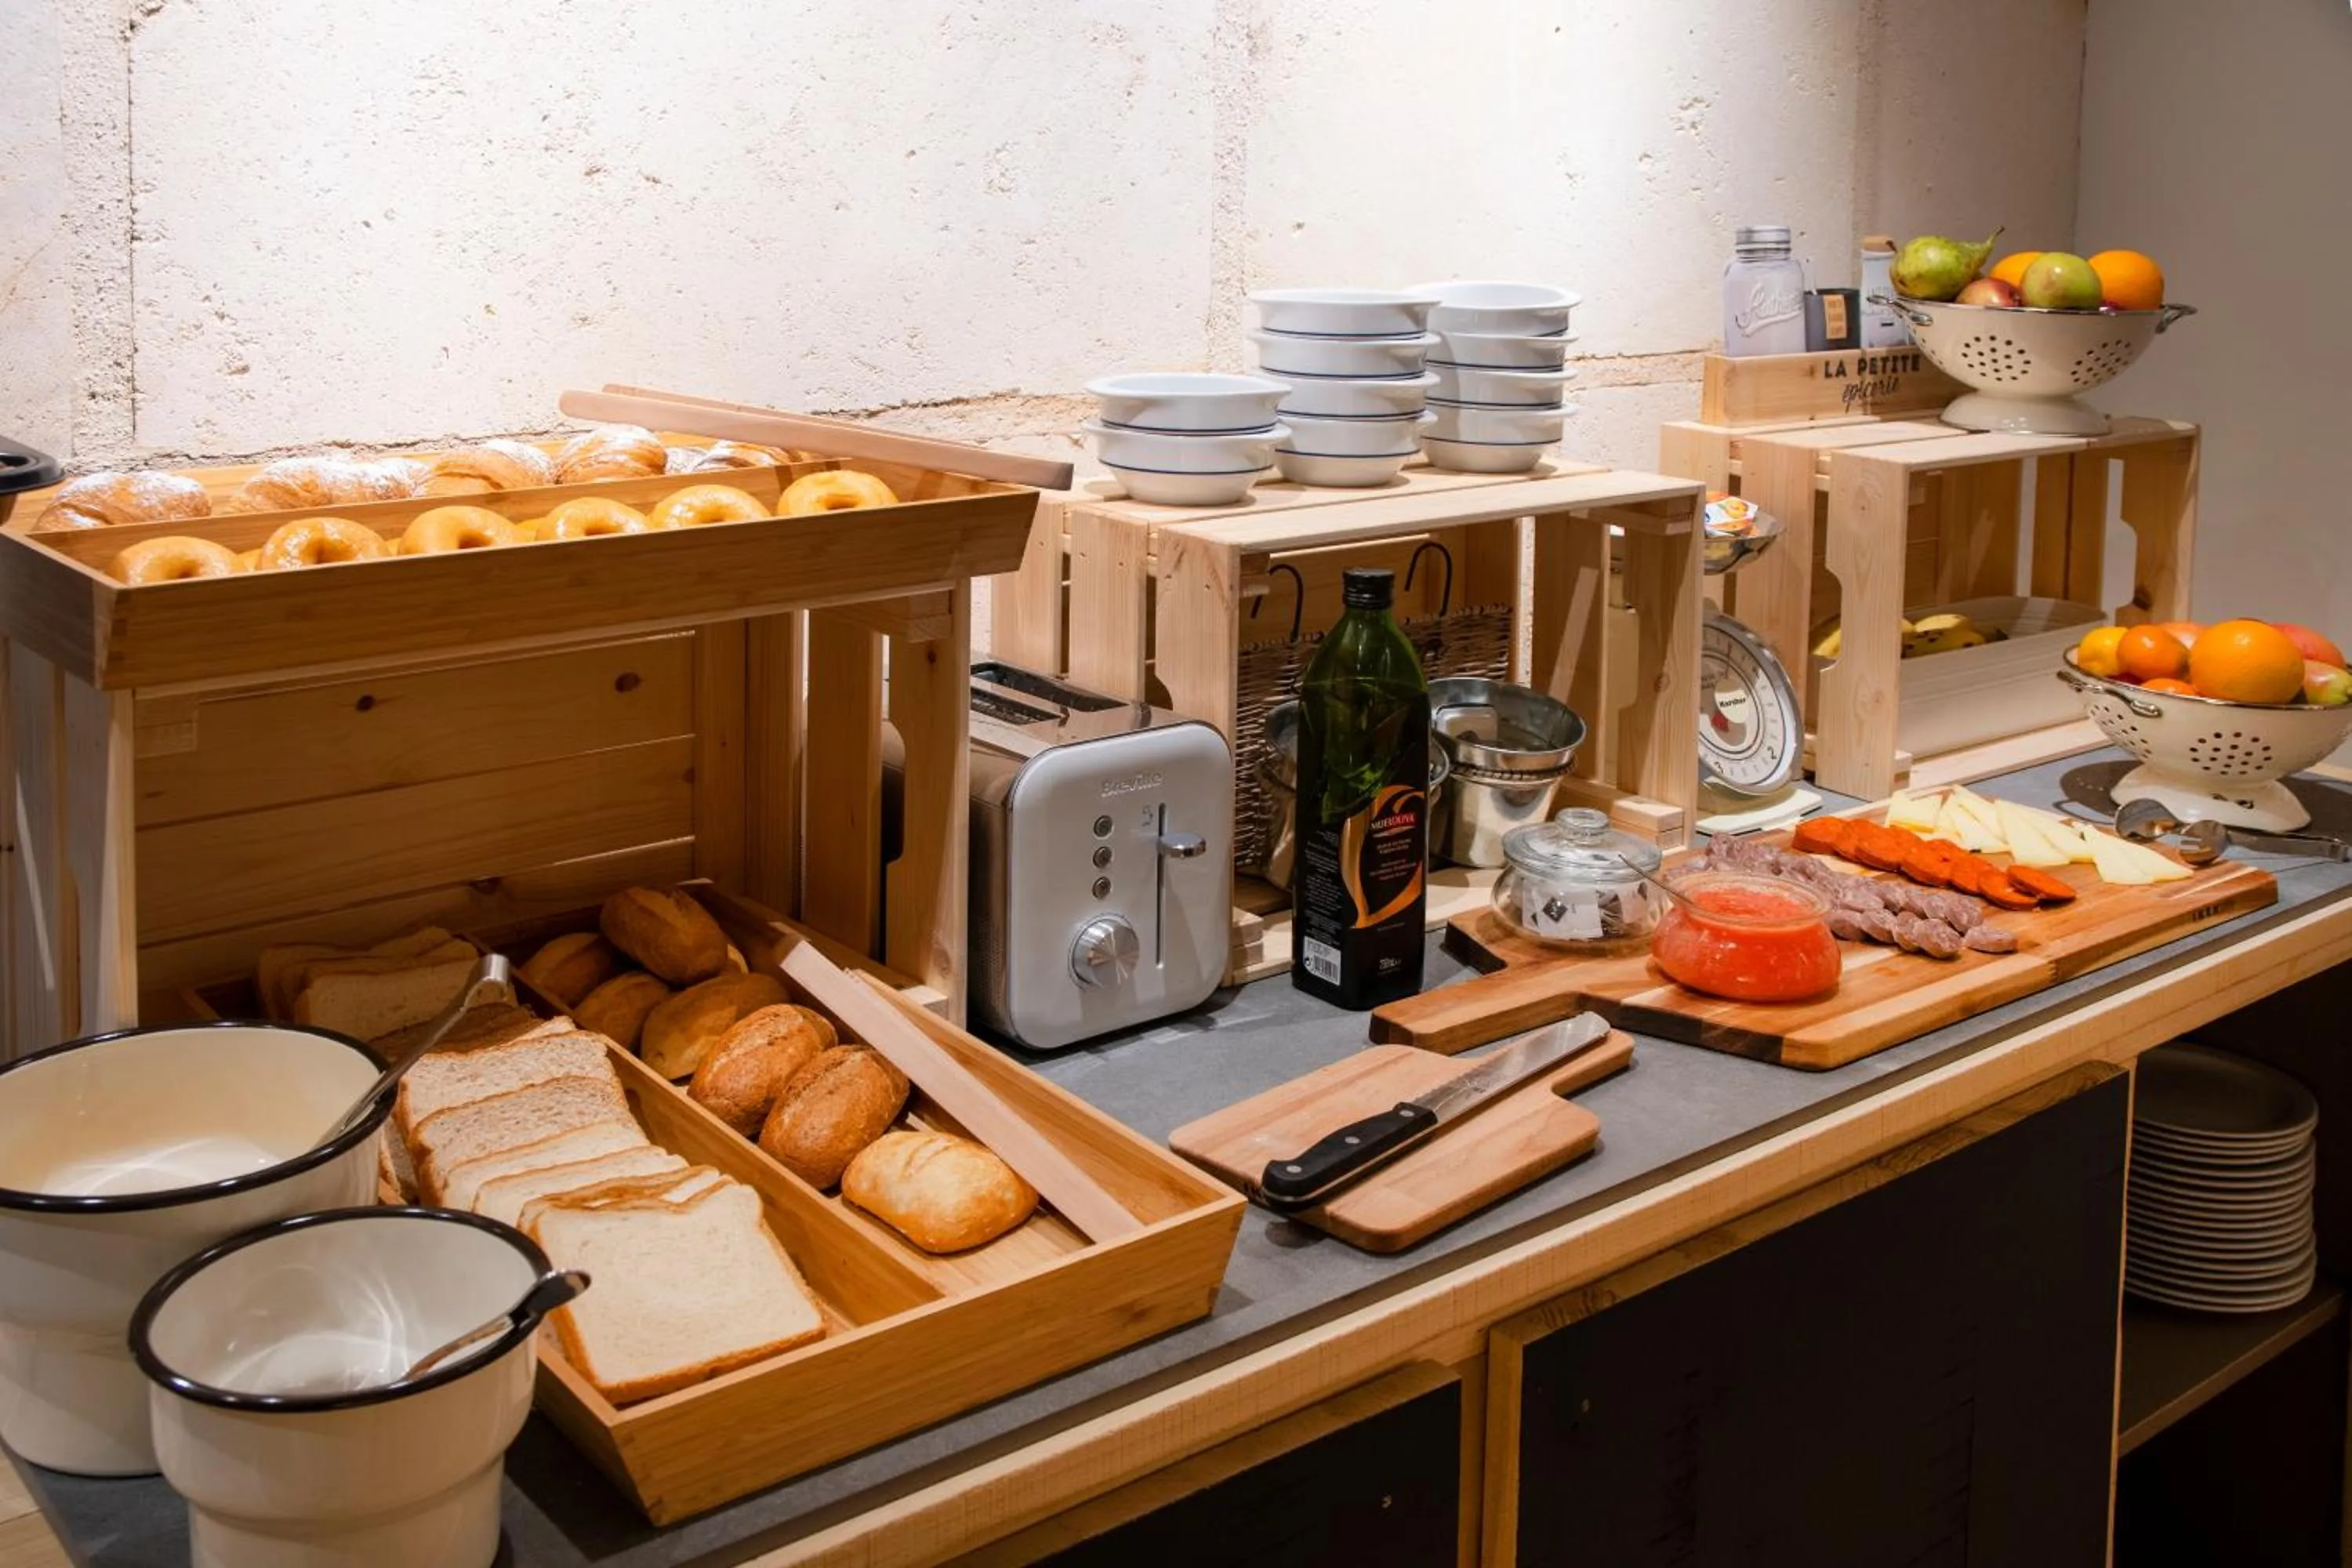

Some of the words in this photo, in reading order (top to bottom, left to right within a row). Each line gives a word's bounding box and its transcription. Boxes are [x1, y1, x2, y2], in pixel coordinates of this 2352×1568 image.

[1824, 358, 1847, 379] LA
[1857, 353, 1921, 376] PETITE
[1766, 746, 1778, 760] 2
